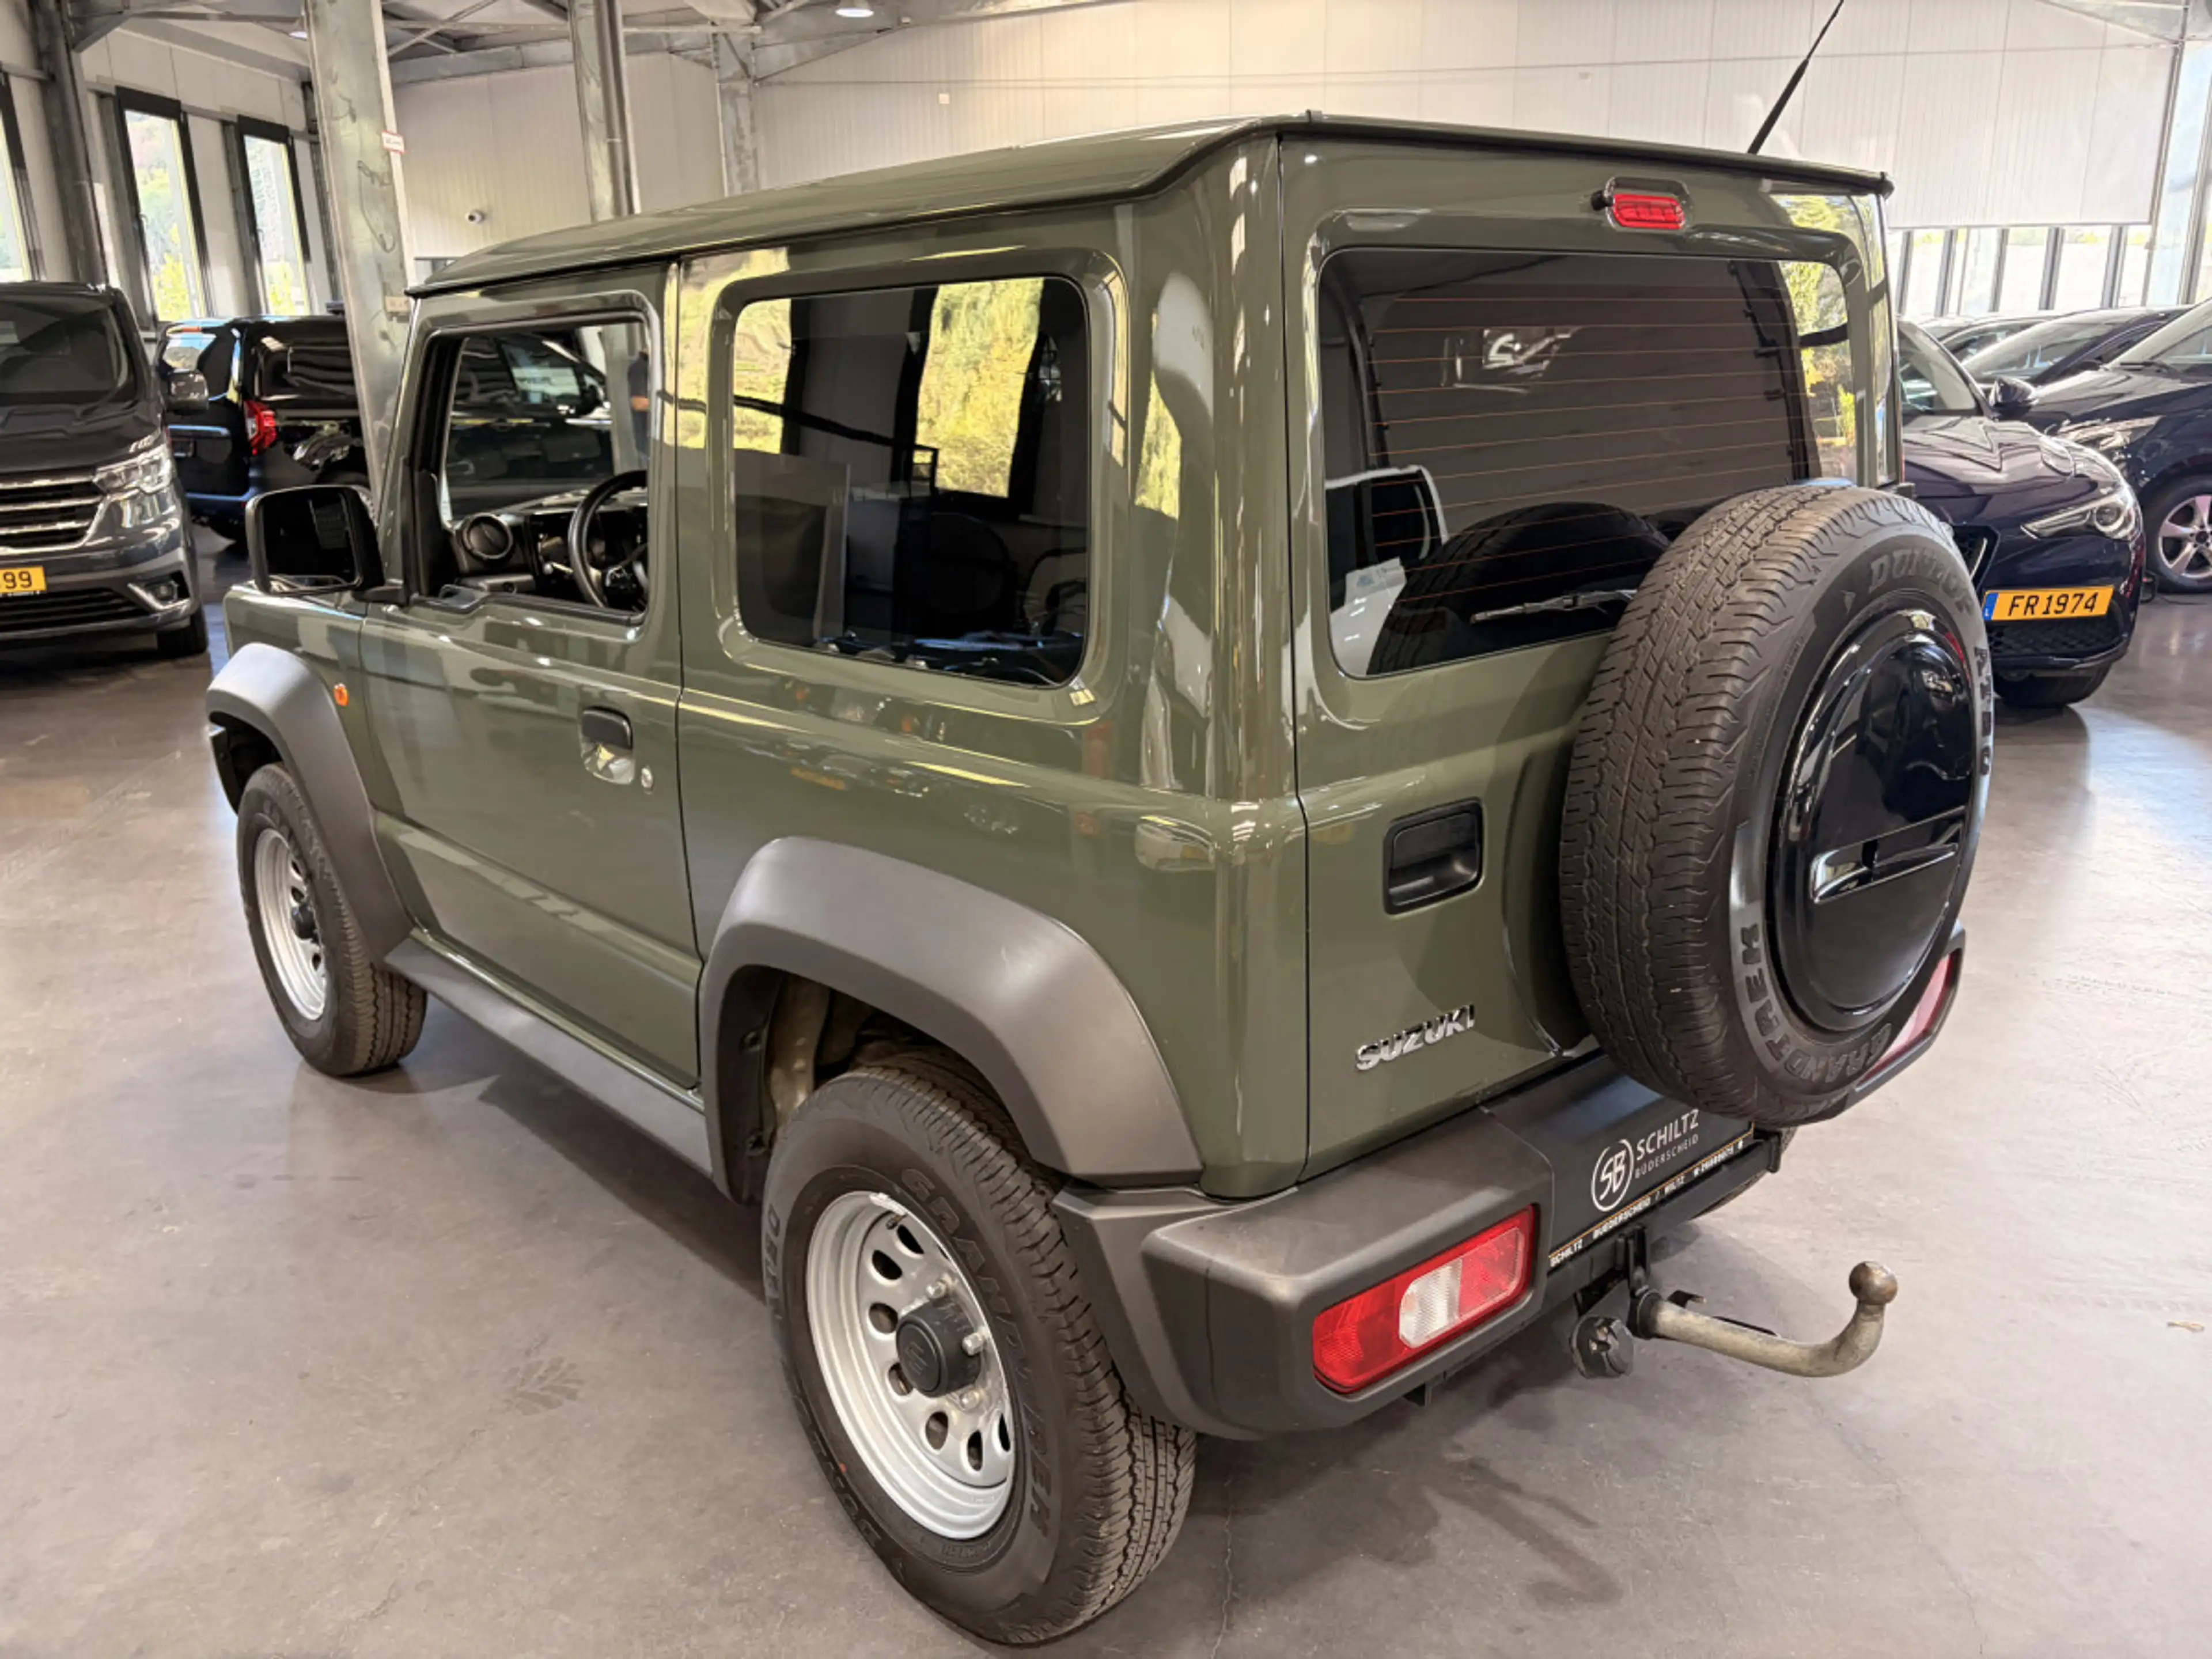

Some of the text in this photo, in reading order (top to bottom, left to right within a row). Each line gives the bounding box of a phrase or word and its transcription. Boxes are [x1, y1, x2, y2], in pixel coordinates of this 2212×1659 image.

[2008, 592, 2099, 616] FR1974
[1740, 923, 1892, 1083] GRANDTREK
[1356, 1004, 1475, 1070] SUZUKI
[1636, 1108, 1699, 1160] SCHILTZ
